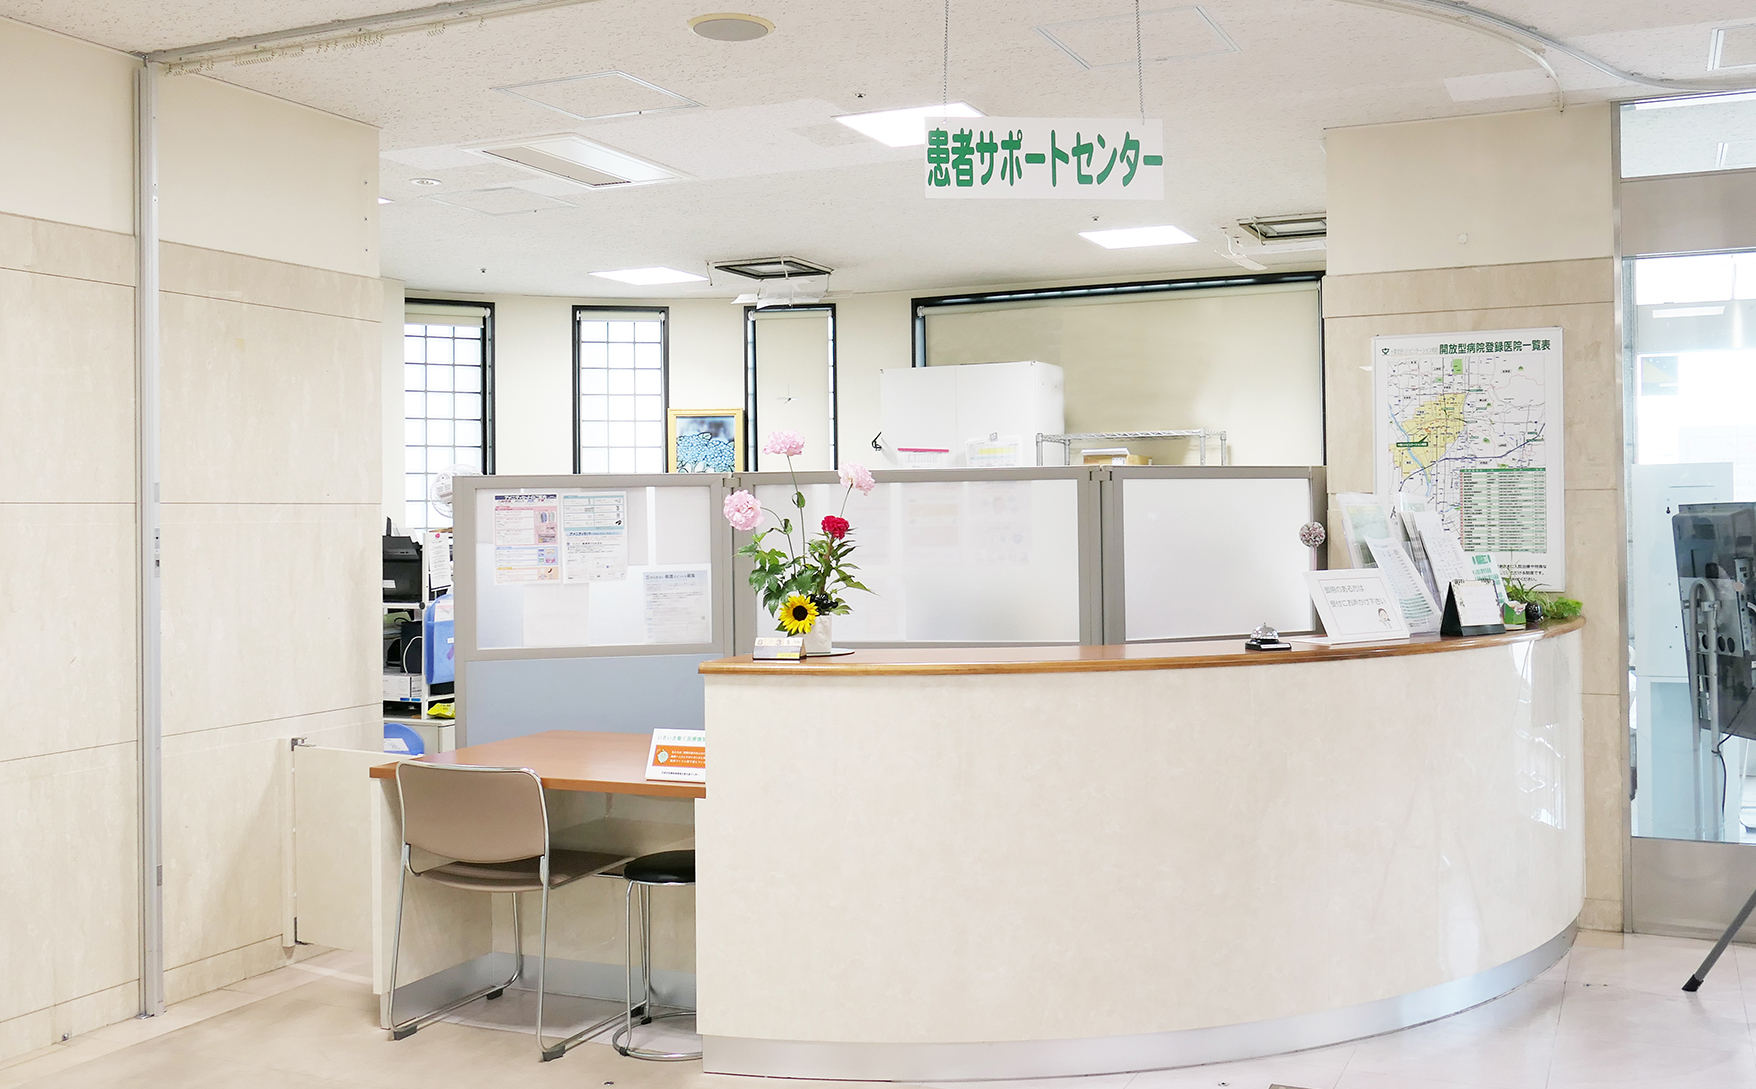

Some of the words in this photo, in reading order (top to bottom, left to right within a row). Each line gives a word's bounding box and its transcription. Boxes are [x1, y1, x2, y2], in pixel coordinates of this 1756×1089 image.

[927, 127, 1163, 187] 患者サポートセンター
[1439, 339, 1551, 355] 開放型病院登録医院一覧表
